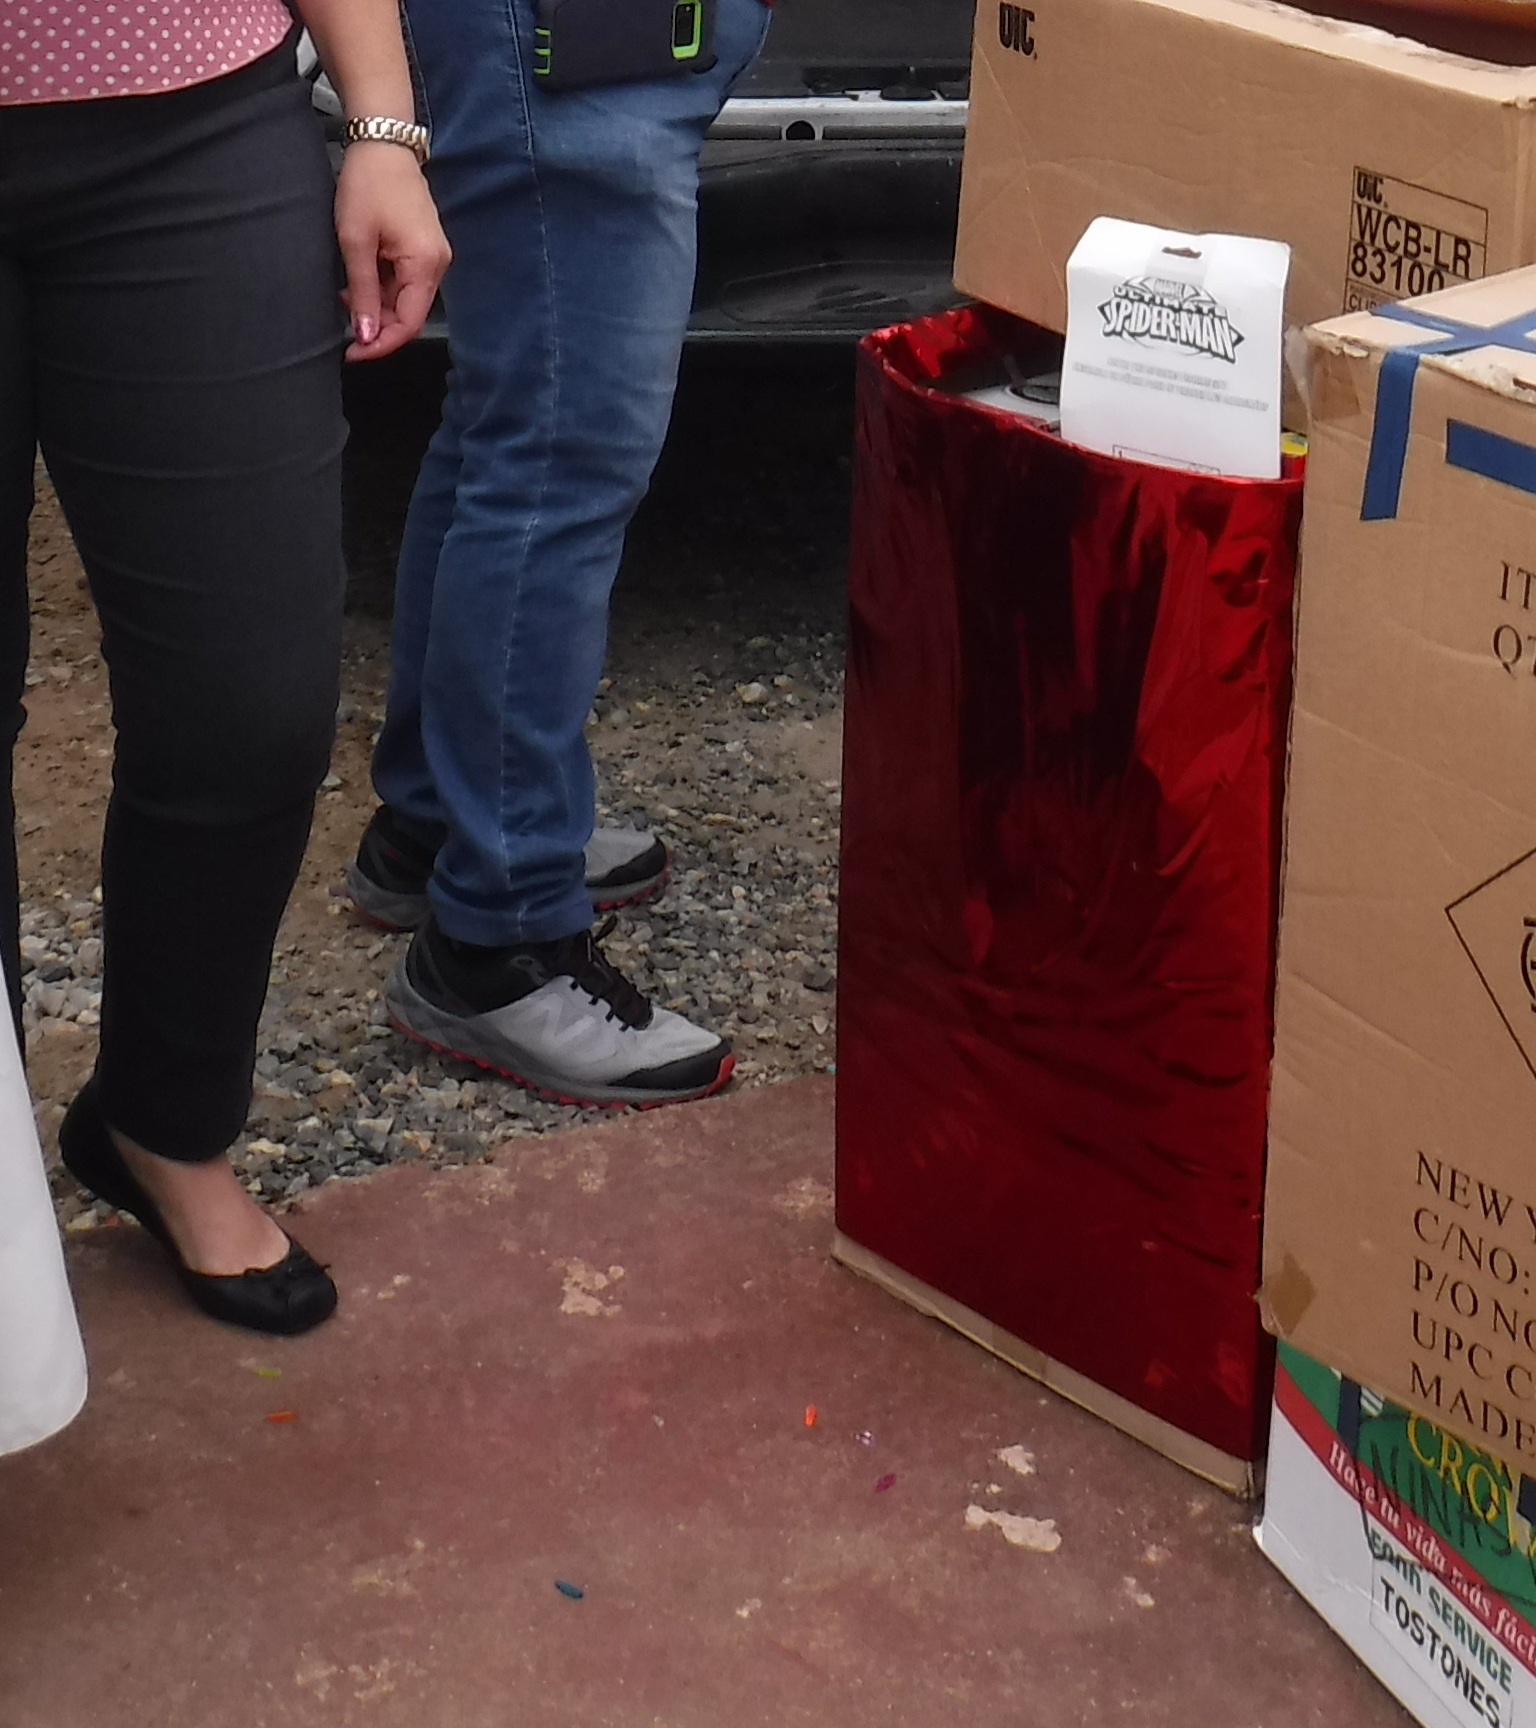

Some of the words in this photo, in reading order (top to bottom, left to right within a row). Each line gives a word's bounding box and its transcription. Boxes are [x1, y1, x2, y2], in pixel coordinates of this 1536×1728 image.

[1351, 241, 1445, 297] 83100
[1356, 203, 1472, 279] WCB-LR
[1113, 285, 1228, 318] ULTIMATE
[1416, 1149, 1513, 1227] NEW
[1413, 1206, 1530, 1296] C/NO:
[1413, 1256, 1479, 1318] P/O
[1412, 1309, 1494, 1380] UPC
[1411, 1360, 1536, 1459] MADE
[1405, 1521, 1447, 1575] vida
[1380, 1576, 1501, 1728] TOSTONES
[1428, 1586, 1513, 1695] SERVICE
